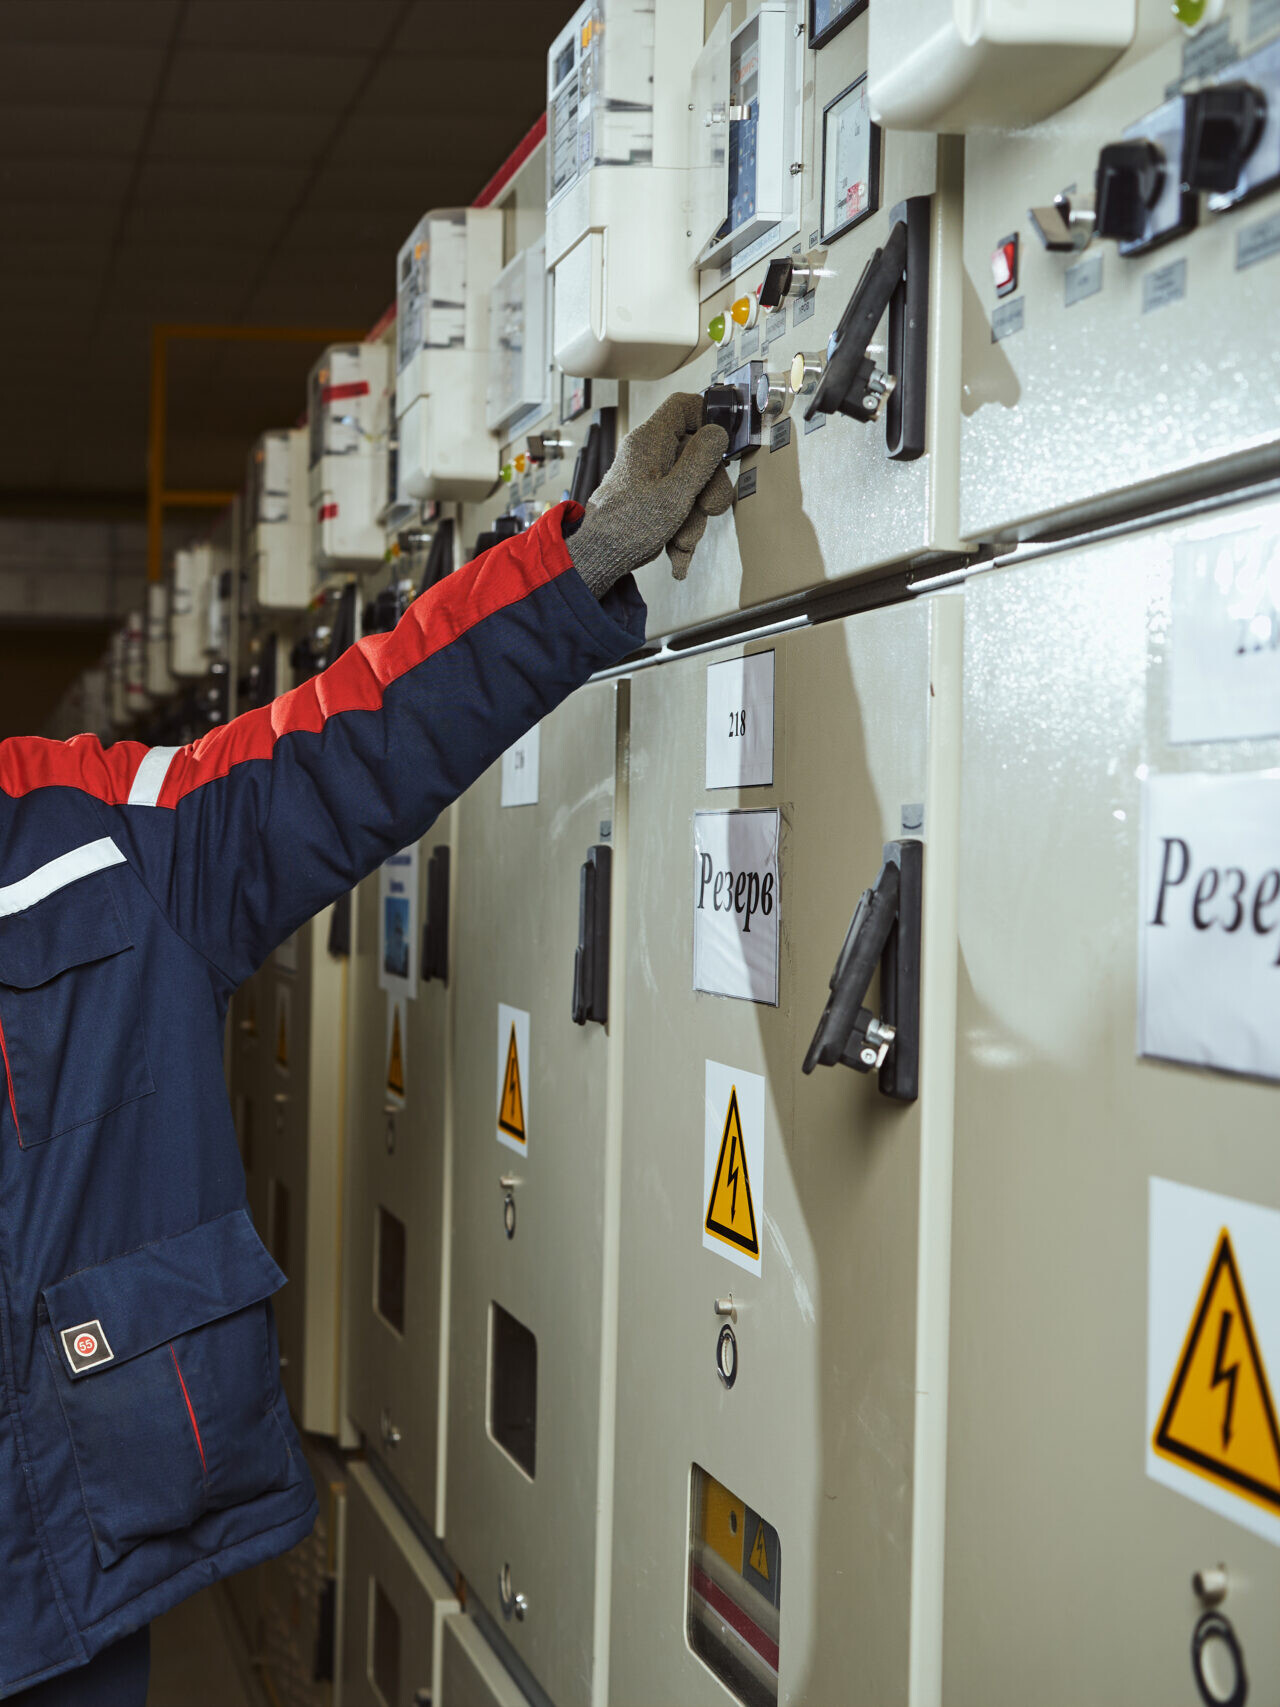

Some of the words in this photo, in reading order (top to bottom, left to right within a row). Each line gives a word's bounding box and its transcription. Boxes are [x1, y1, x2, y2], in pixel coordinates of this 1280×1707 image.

[728, 709, 747, 737] 218
[696, 851, 775, 933] Резерв
[1147, 836, 1280, 968] Резе
[78, 1338, 94, 1352] 55
